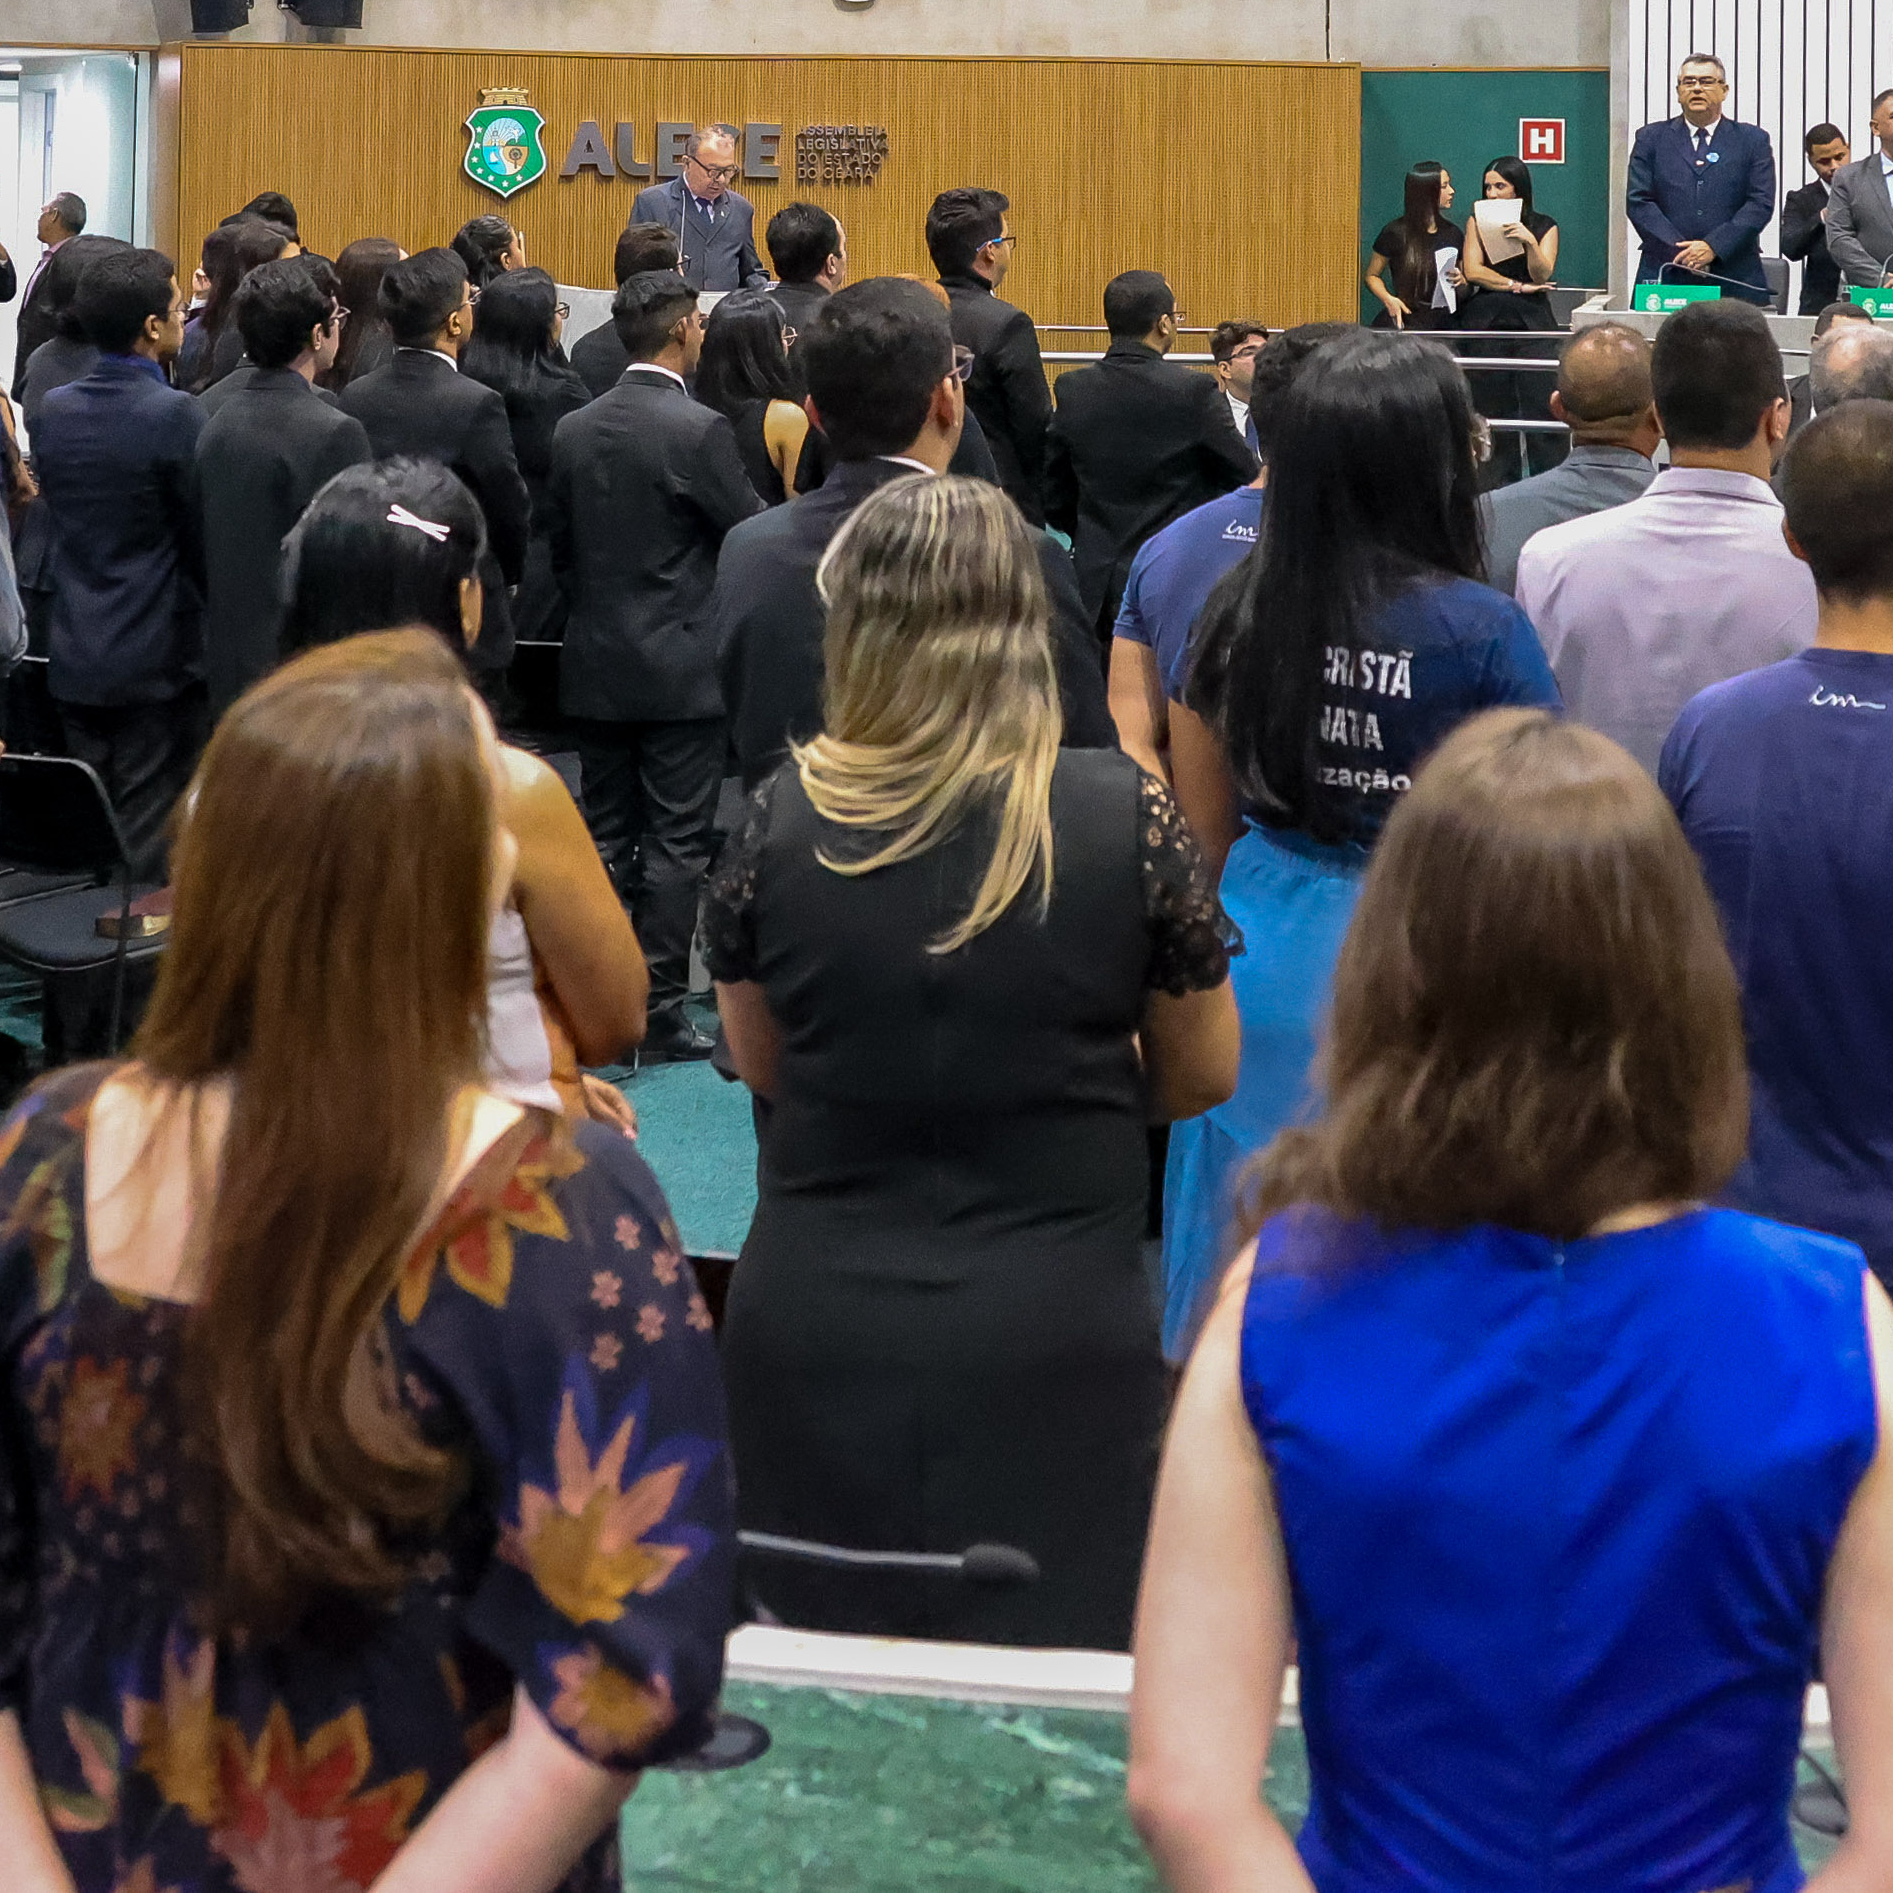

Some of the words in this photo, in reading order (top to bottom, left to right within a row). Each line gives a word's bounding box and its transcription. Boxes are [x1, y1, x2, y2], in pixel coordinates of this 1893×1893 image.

[798, 137, 888, 150] LEGISLATIVA
[1530, 128, 1554, 154] H
[559, 120, 782, 179] ALEE
[798, 152, 818, 165] DO
[825, 152, 882, 165] ESTADO
[798, 167, 818, 179] DO
